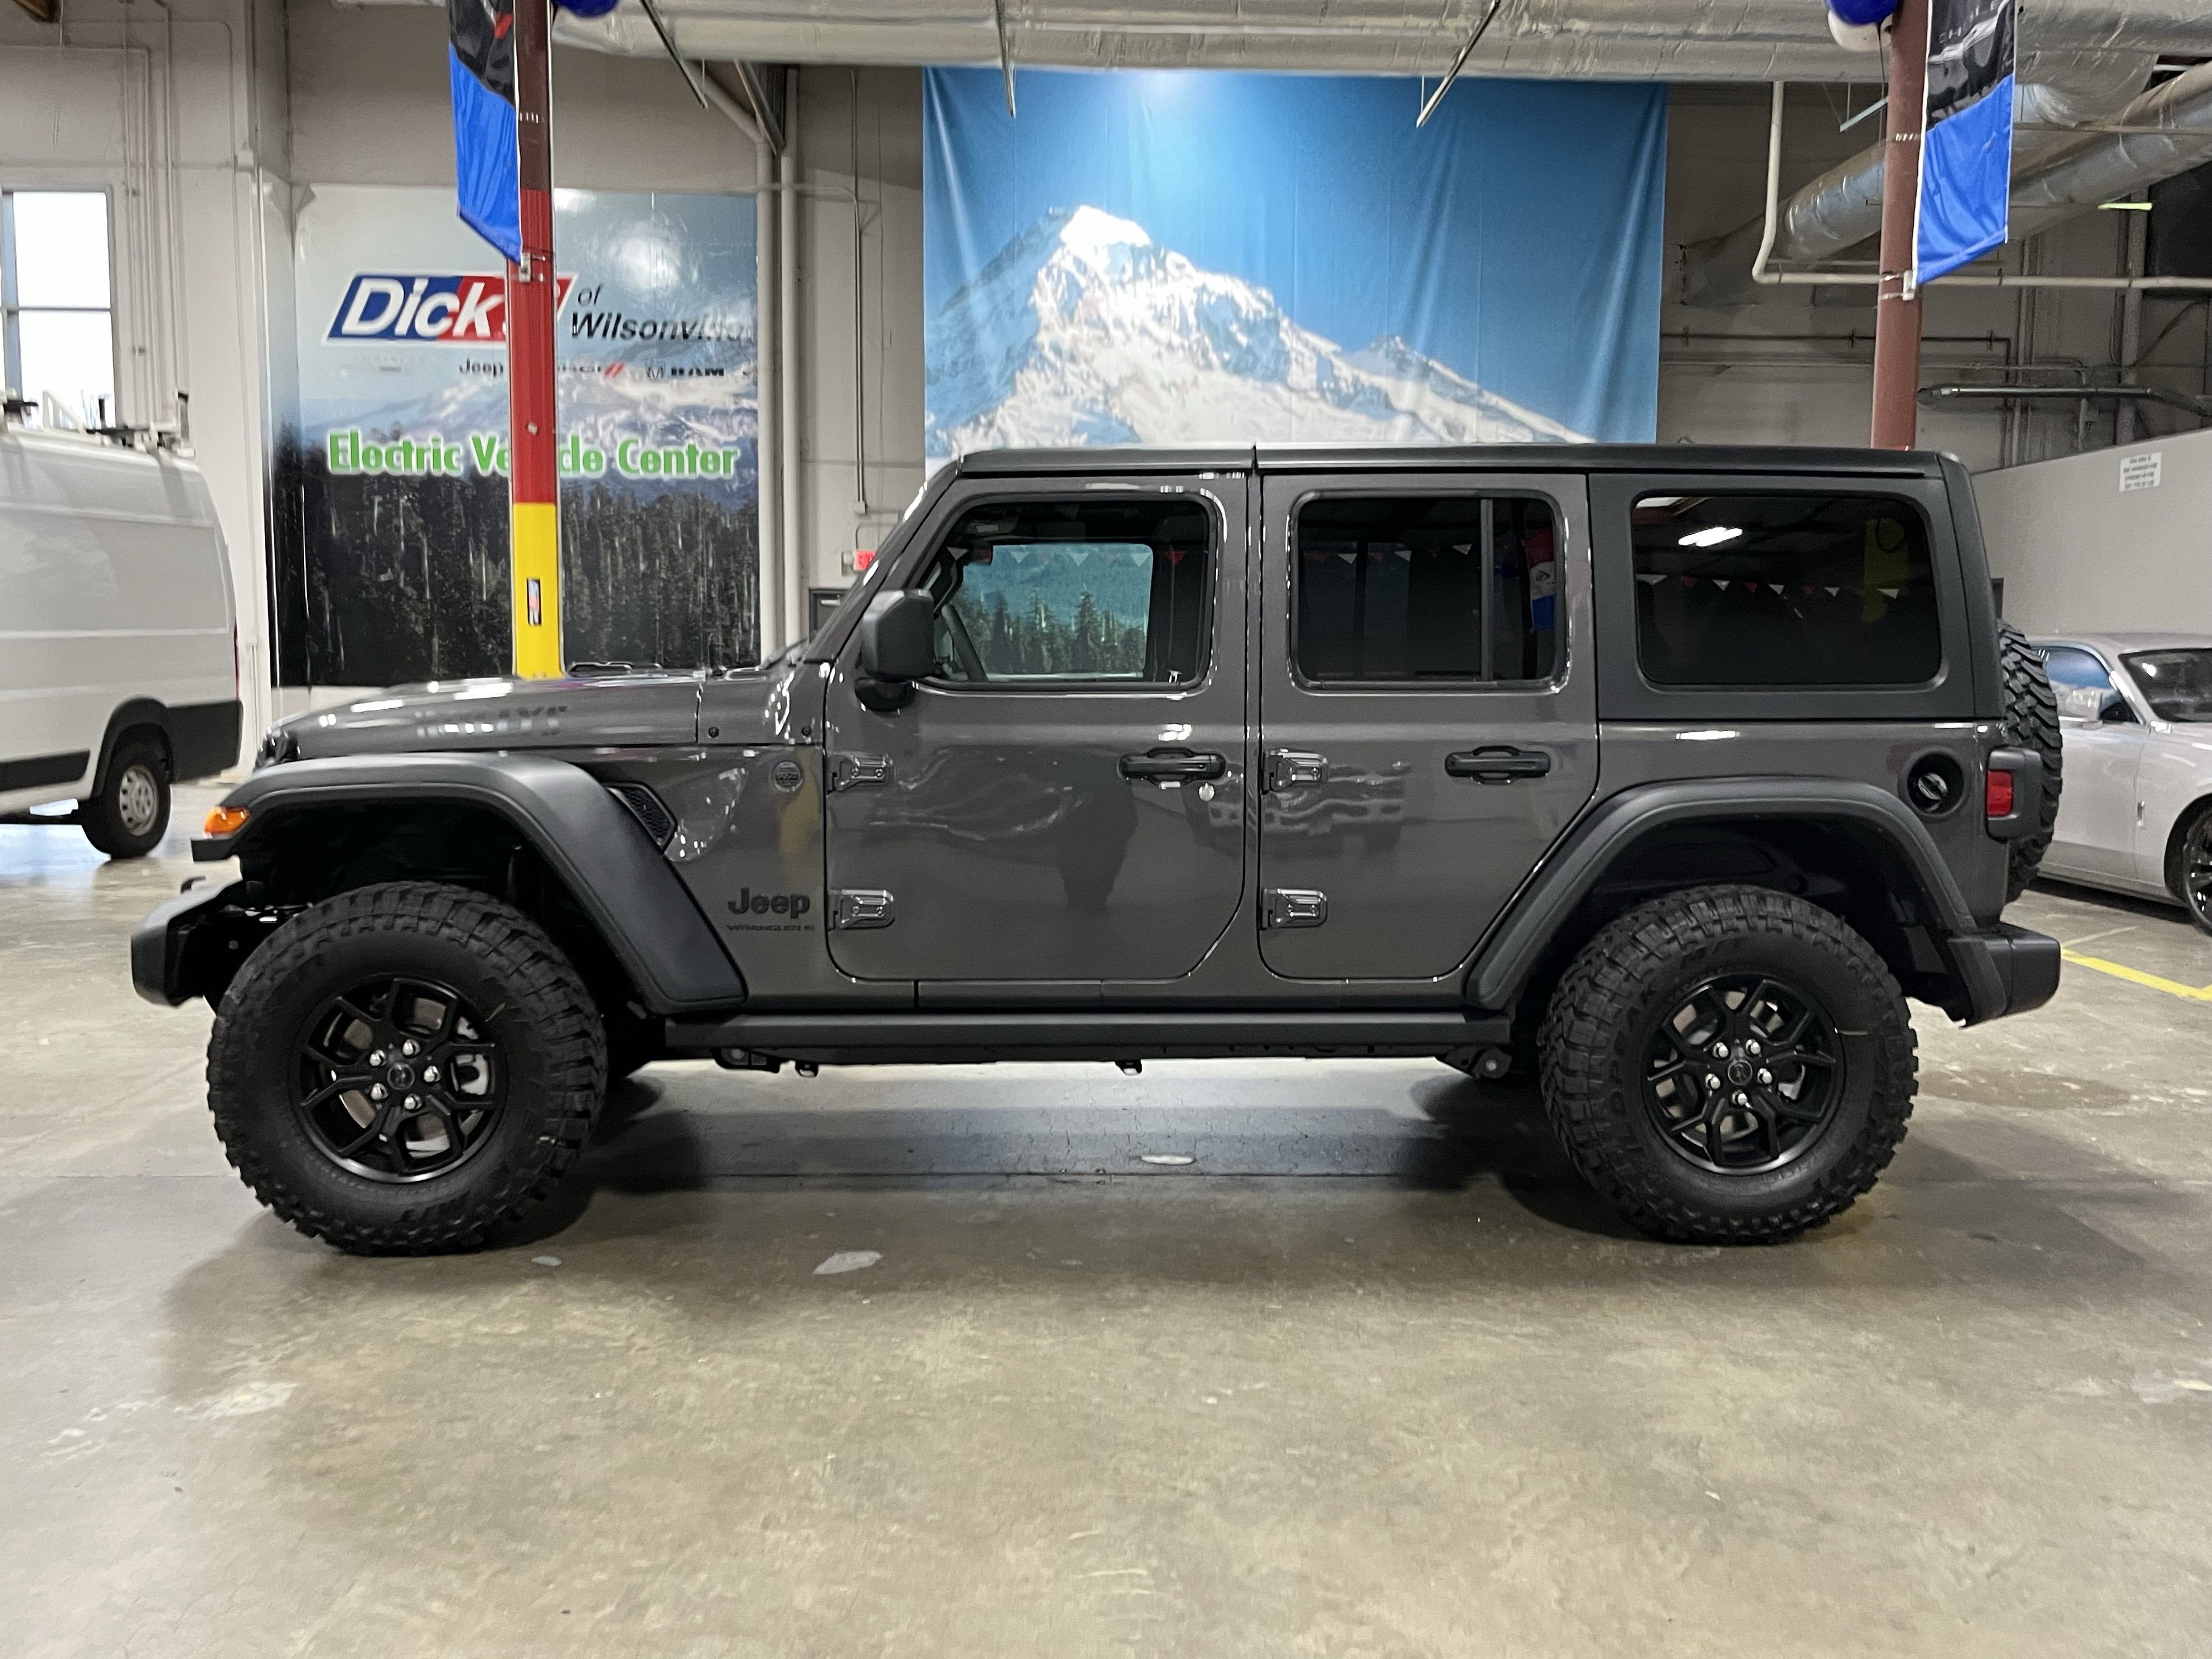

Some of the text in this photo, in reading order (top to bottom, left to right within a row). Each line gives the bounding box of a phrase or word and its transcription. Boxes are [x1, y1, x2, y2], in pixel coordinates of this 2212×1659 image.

[341, 278, 560, 339] Dick
[578, 283, 603, 306] of
[329, 429, 738, 474] Electric Vecle Center
[727, 887, 811, 919] Jeep
